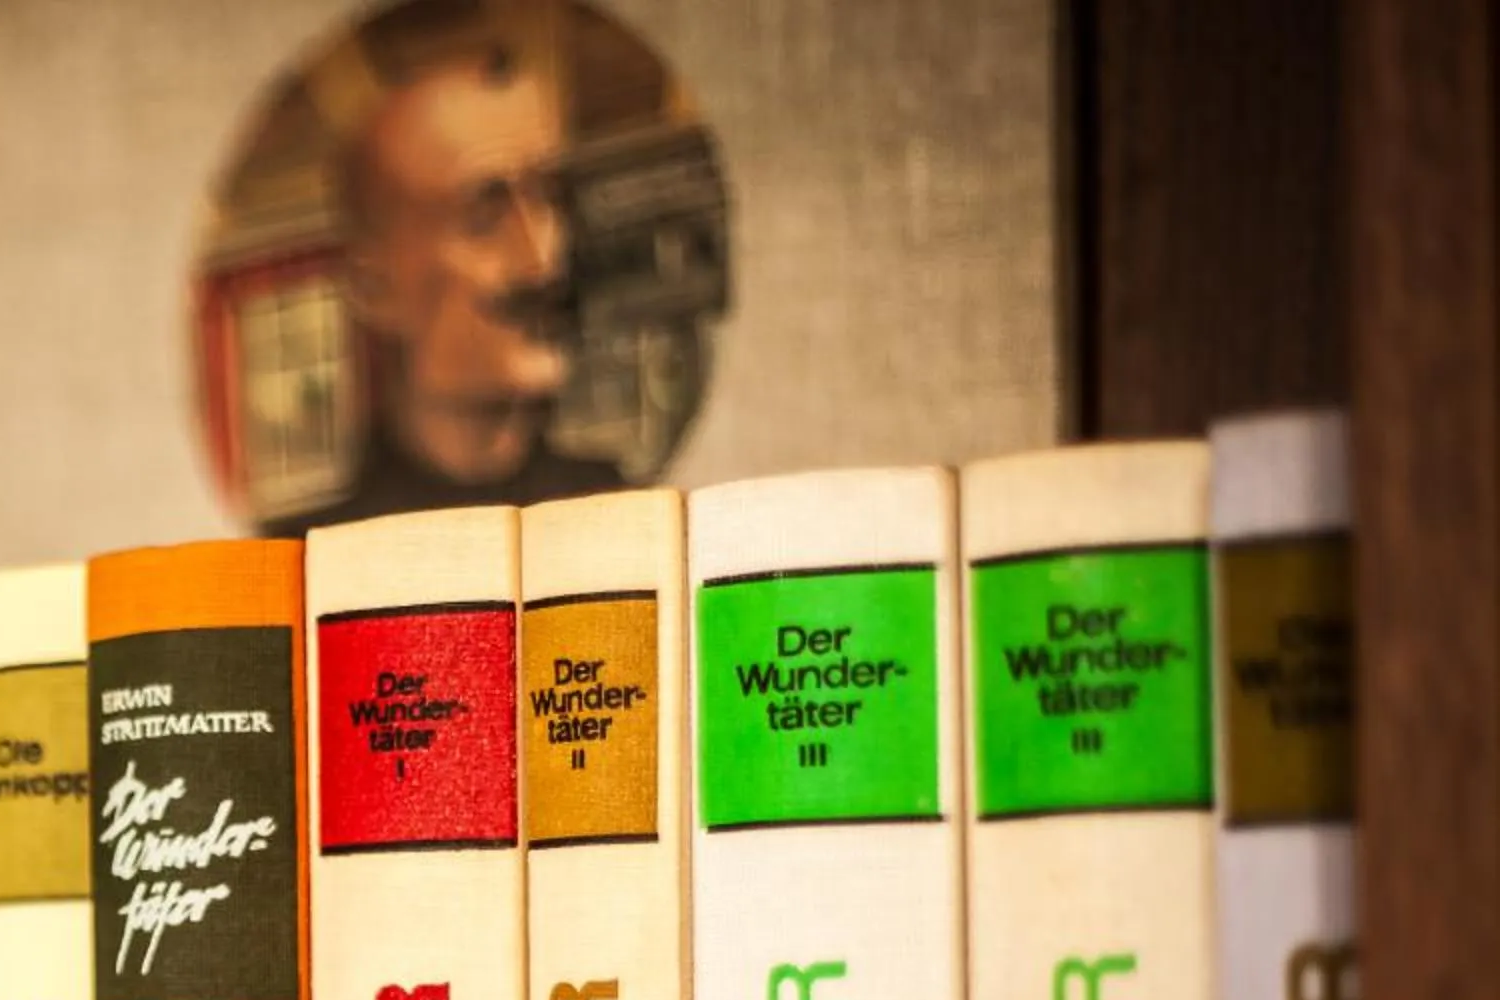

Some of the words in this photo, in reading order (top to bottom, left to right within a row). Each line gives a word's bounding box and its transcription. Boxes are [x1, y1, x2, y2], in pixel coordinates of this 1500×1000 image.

[1046, 604, 1126, 642] Der
[777, 624, 851, 657] Der
[378, 673, 427, 697] Der
[554, 658, 605, 686] Der
[736, 657, 908, 696] Wunder-
[102, 684, 173, 714] ERWIN
[350, 697, 469, 727] Wunder-
[530, 683, 647, 716] Wunder-
[766, 697, 862, 732] täter
[1037, 680, 1140, 717] täter
[102, 711, 274, 744] STRITTMATTER
[369, 725, 435, 752] täter
[547, 714, 613, 745] täter
[572, 749, 585, 770] II
[799, 743, 827, 768] III
[99, 760, 186, 843] Der
